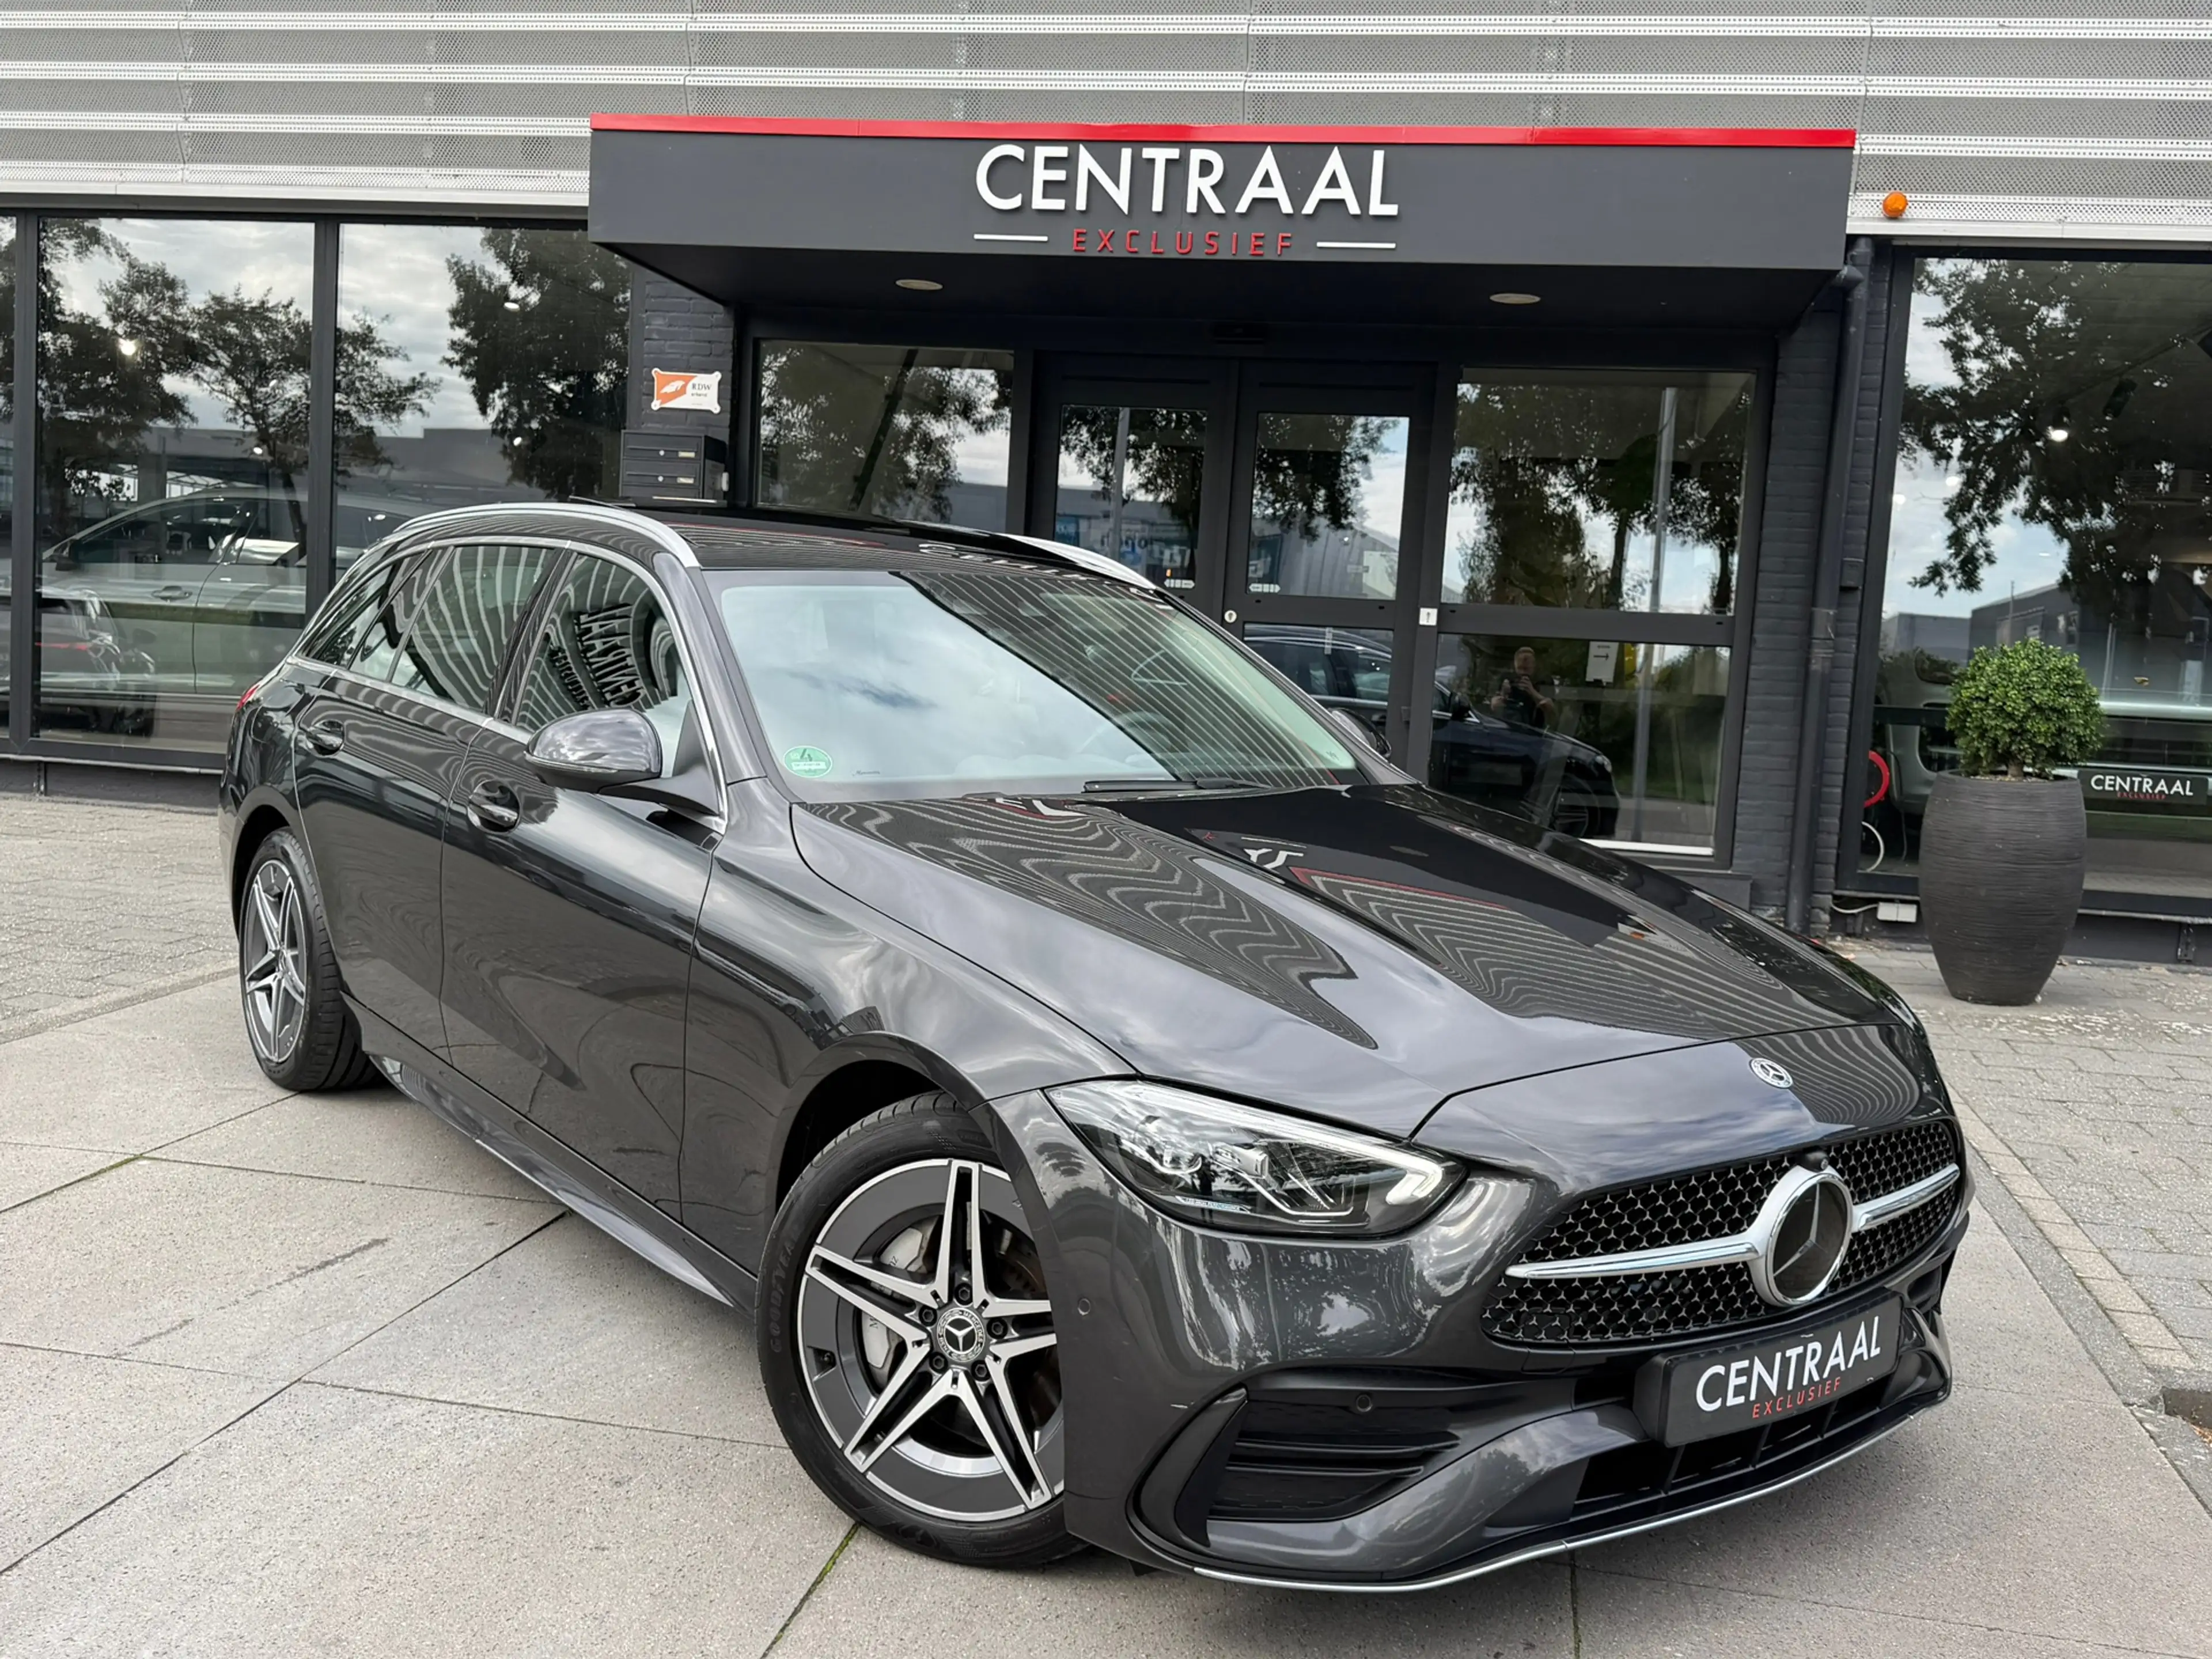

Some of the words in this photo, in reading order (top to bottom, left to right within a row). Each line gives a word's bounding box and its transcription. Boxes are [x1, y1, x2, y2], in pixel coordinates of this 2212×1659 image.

[975, 143, 1399, 216] CENTRAAL
[1072, 228, 1292, 256] EXCLUSIEF
[692, 382, 712, 391] RDW
[2090, 774, 2194, 796] CENTRAAL
[1696, 1316, 1880, 1412] CENTRAAL
[1752, 1376, 1842, 1419] EXCLUSIEF
